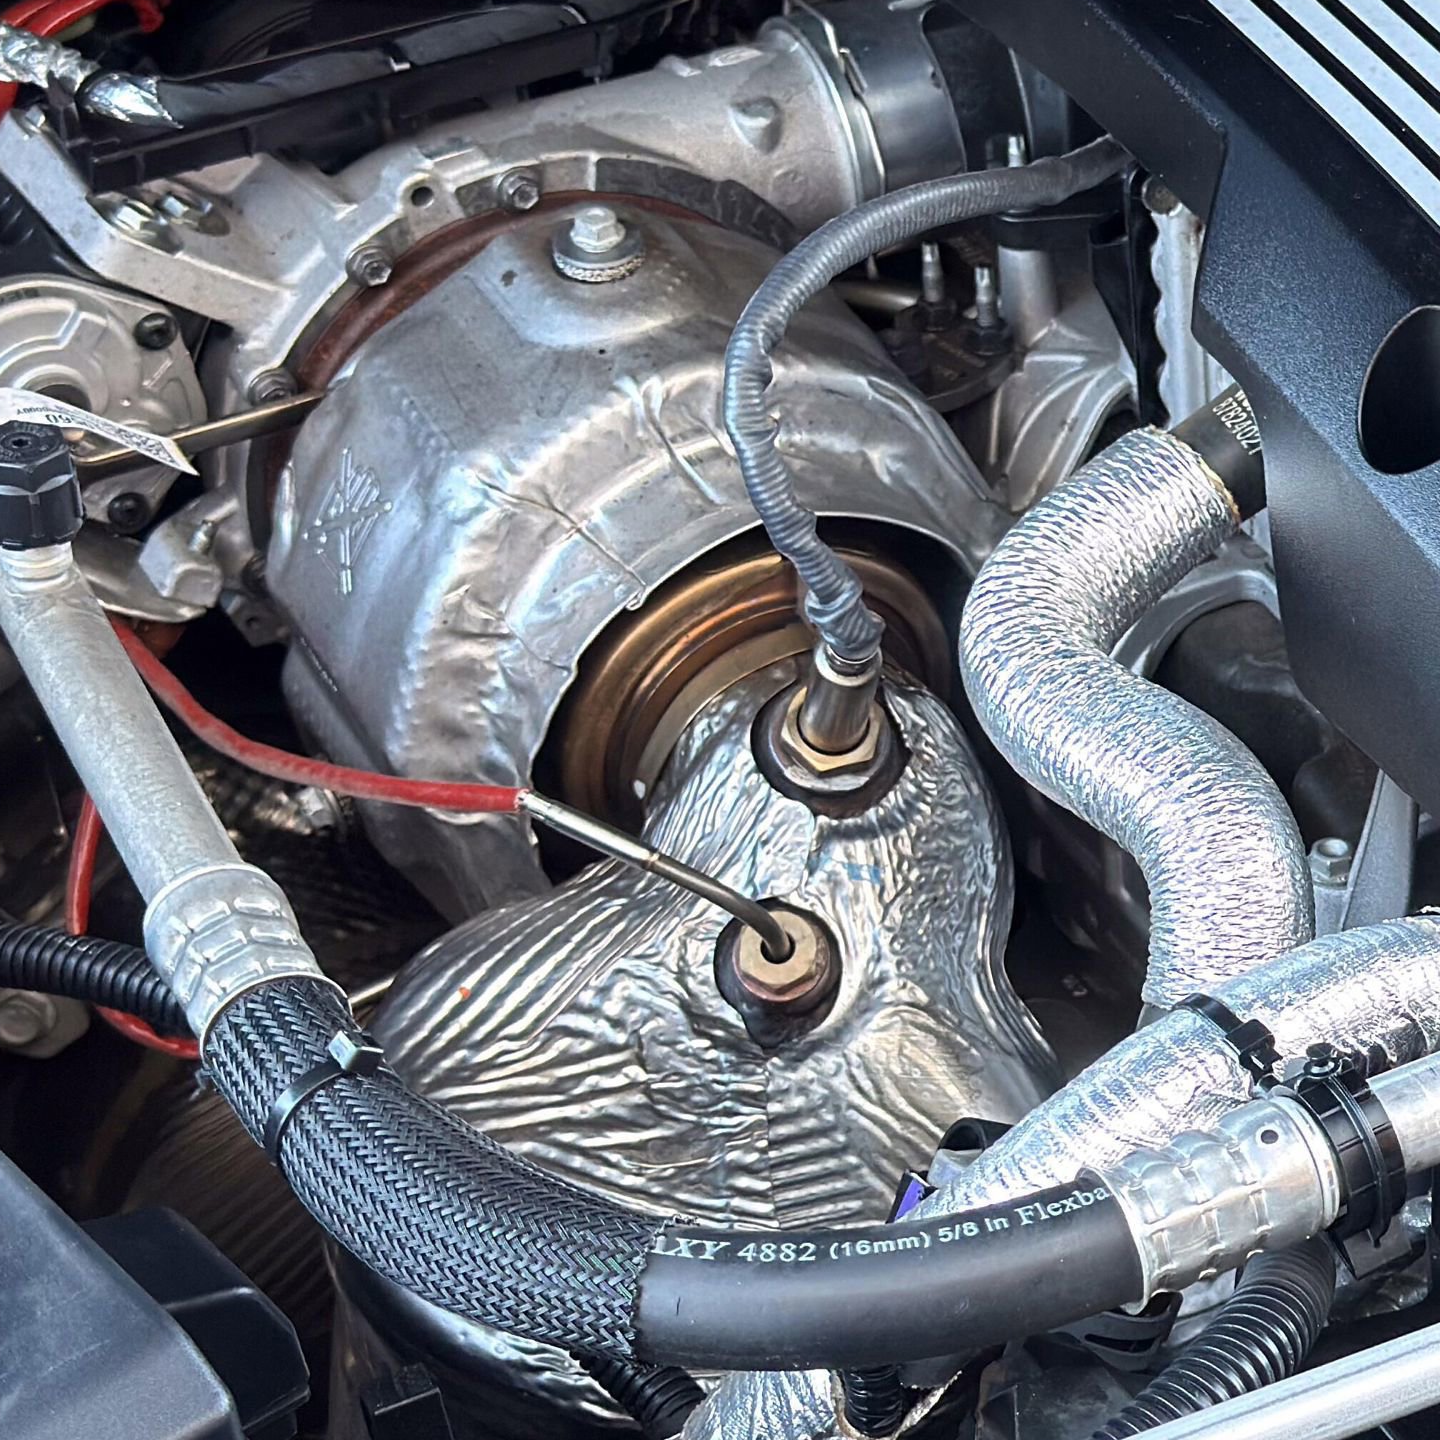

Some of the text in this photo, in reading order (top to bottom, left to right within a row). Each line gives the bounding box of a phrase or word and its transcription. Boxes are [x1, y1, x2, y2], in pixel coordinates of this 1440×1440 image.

[737, 1241, 817, 1262] 4882
[829, 1231, 931, 1260] (16mm)
[938, 1221, 980, 1243] 5/8
